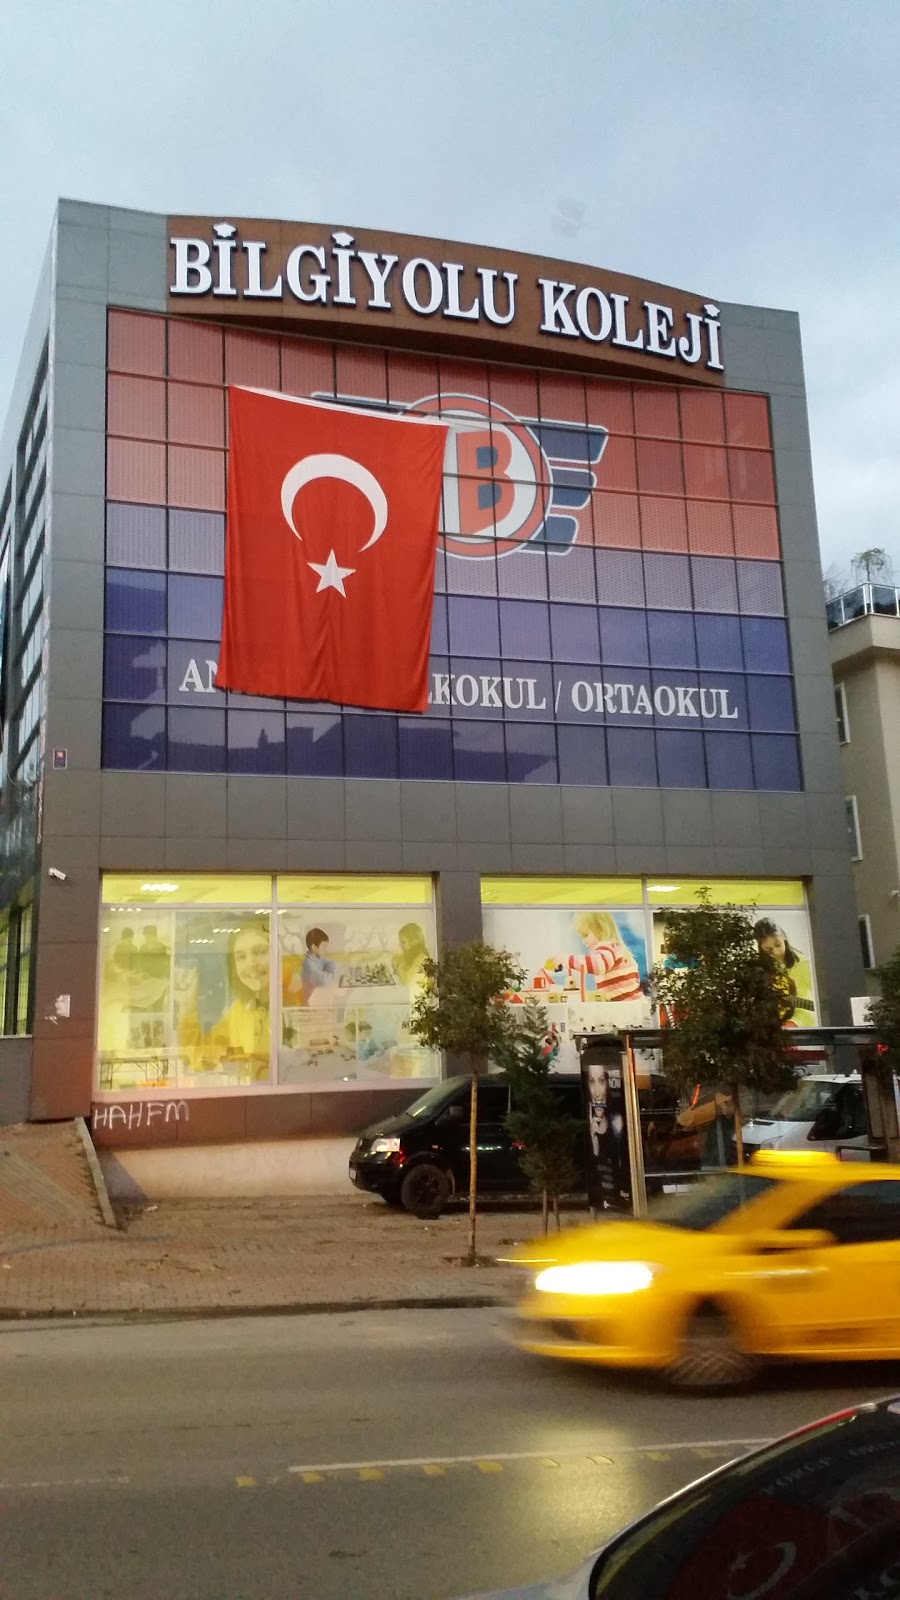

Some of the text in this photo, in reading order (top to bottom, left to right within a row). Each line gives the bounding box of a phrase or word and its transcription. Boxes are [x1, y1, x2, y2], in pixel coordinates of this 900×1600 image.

[169, 221, 725, 371] BİLGİYOLU KOLEJİ
[428, 673, 547, 710] KOKUL
[570, 680, 739, 720] ORTAOKUL
